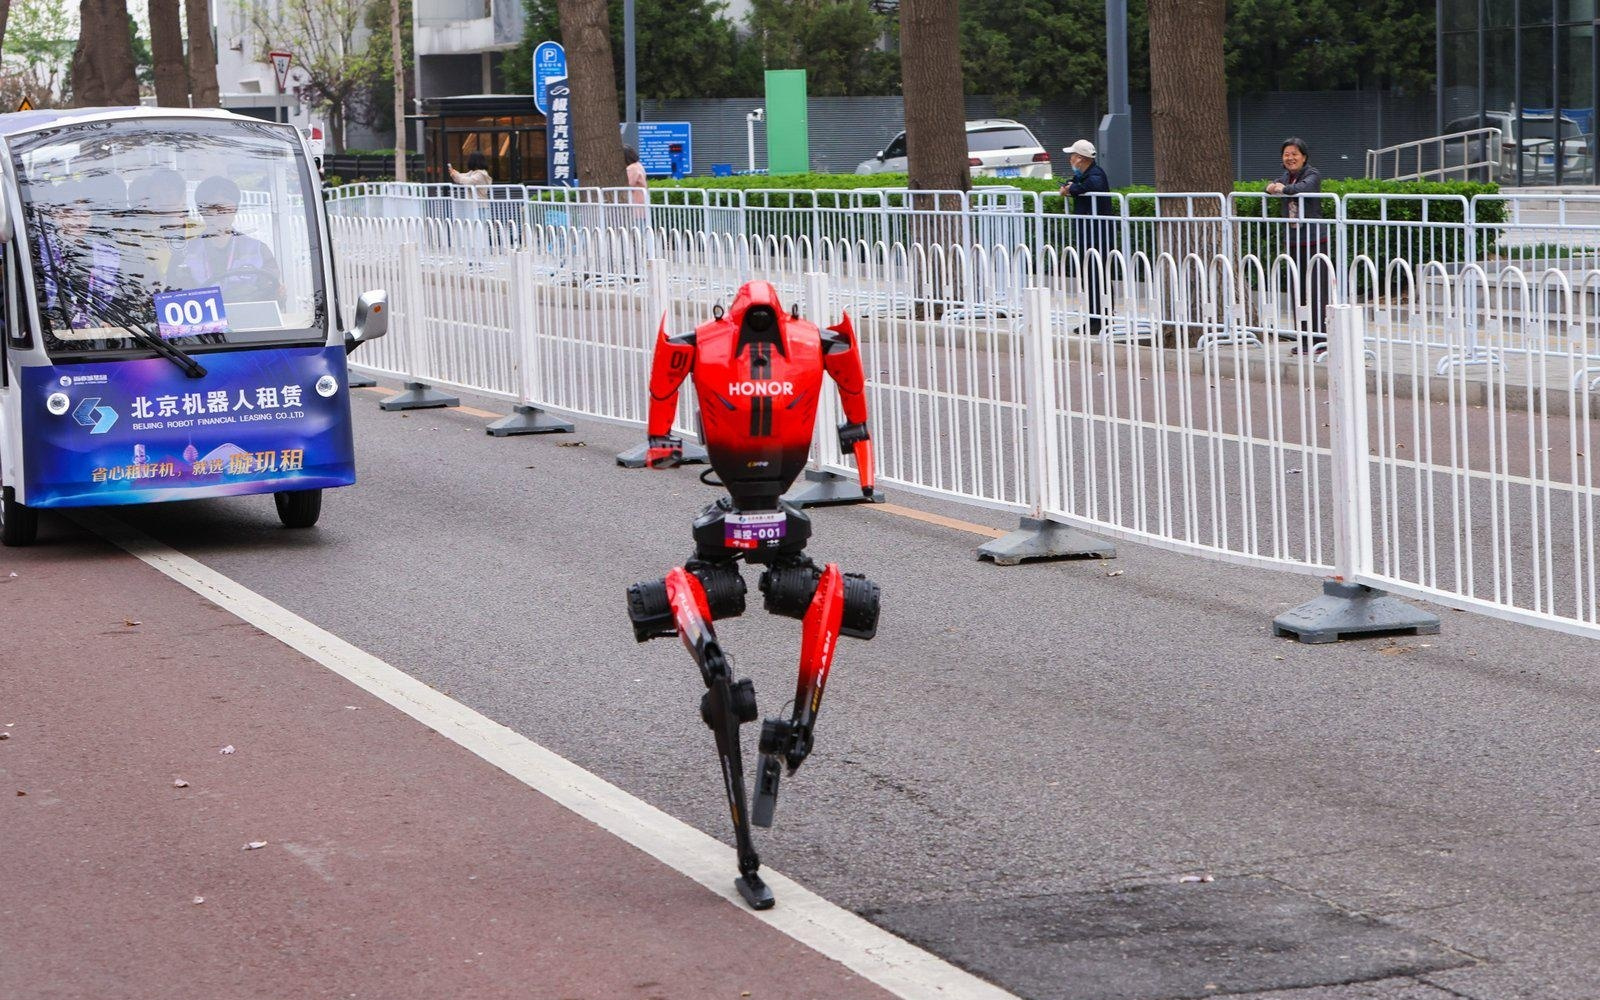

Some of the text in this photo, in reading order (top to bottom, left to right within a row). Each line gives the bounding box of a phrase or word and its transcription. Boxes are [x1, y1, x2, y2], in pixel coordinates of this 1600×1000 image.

[545, 50, 555, 60] P
[164, 297, 219, 326] 001
[728, 381, 794, 396] HONOR
[131, 384, 303, 419] 北京机器人租赁
[132, 421, 164, 430] BEIJING
[166, 419, 194, 428] ROBOT
[197, 416, 237, 426] FINANCIAL
[240, 412, 272, 422] LEASING
